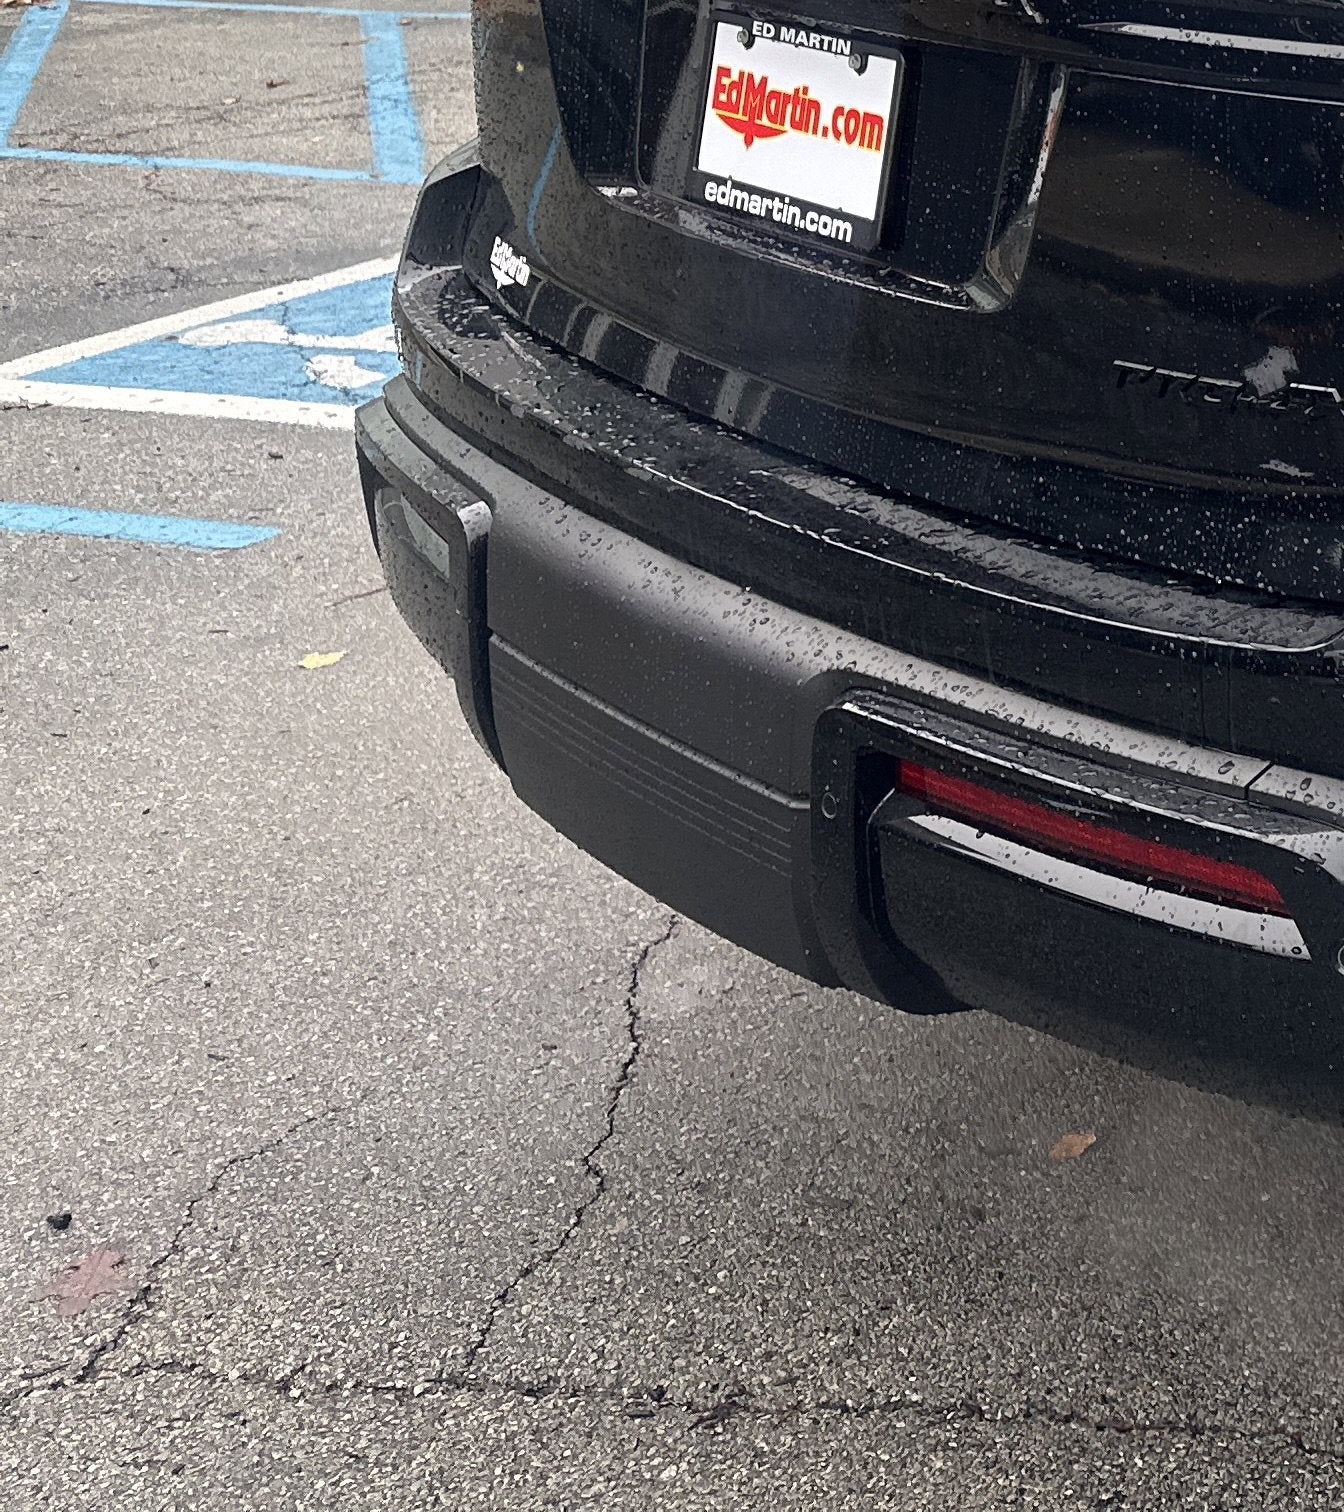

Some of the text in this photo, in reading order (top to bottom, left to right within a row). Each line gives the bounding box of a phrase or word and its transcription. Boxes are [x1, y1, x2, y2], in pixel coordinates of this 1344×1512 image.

[752, 21, 852, 55] ED MARTIN
[712, 65, 885, 153] EdMartin.com
[704, 178, 853, 244] edmartin.com
